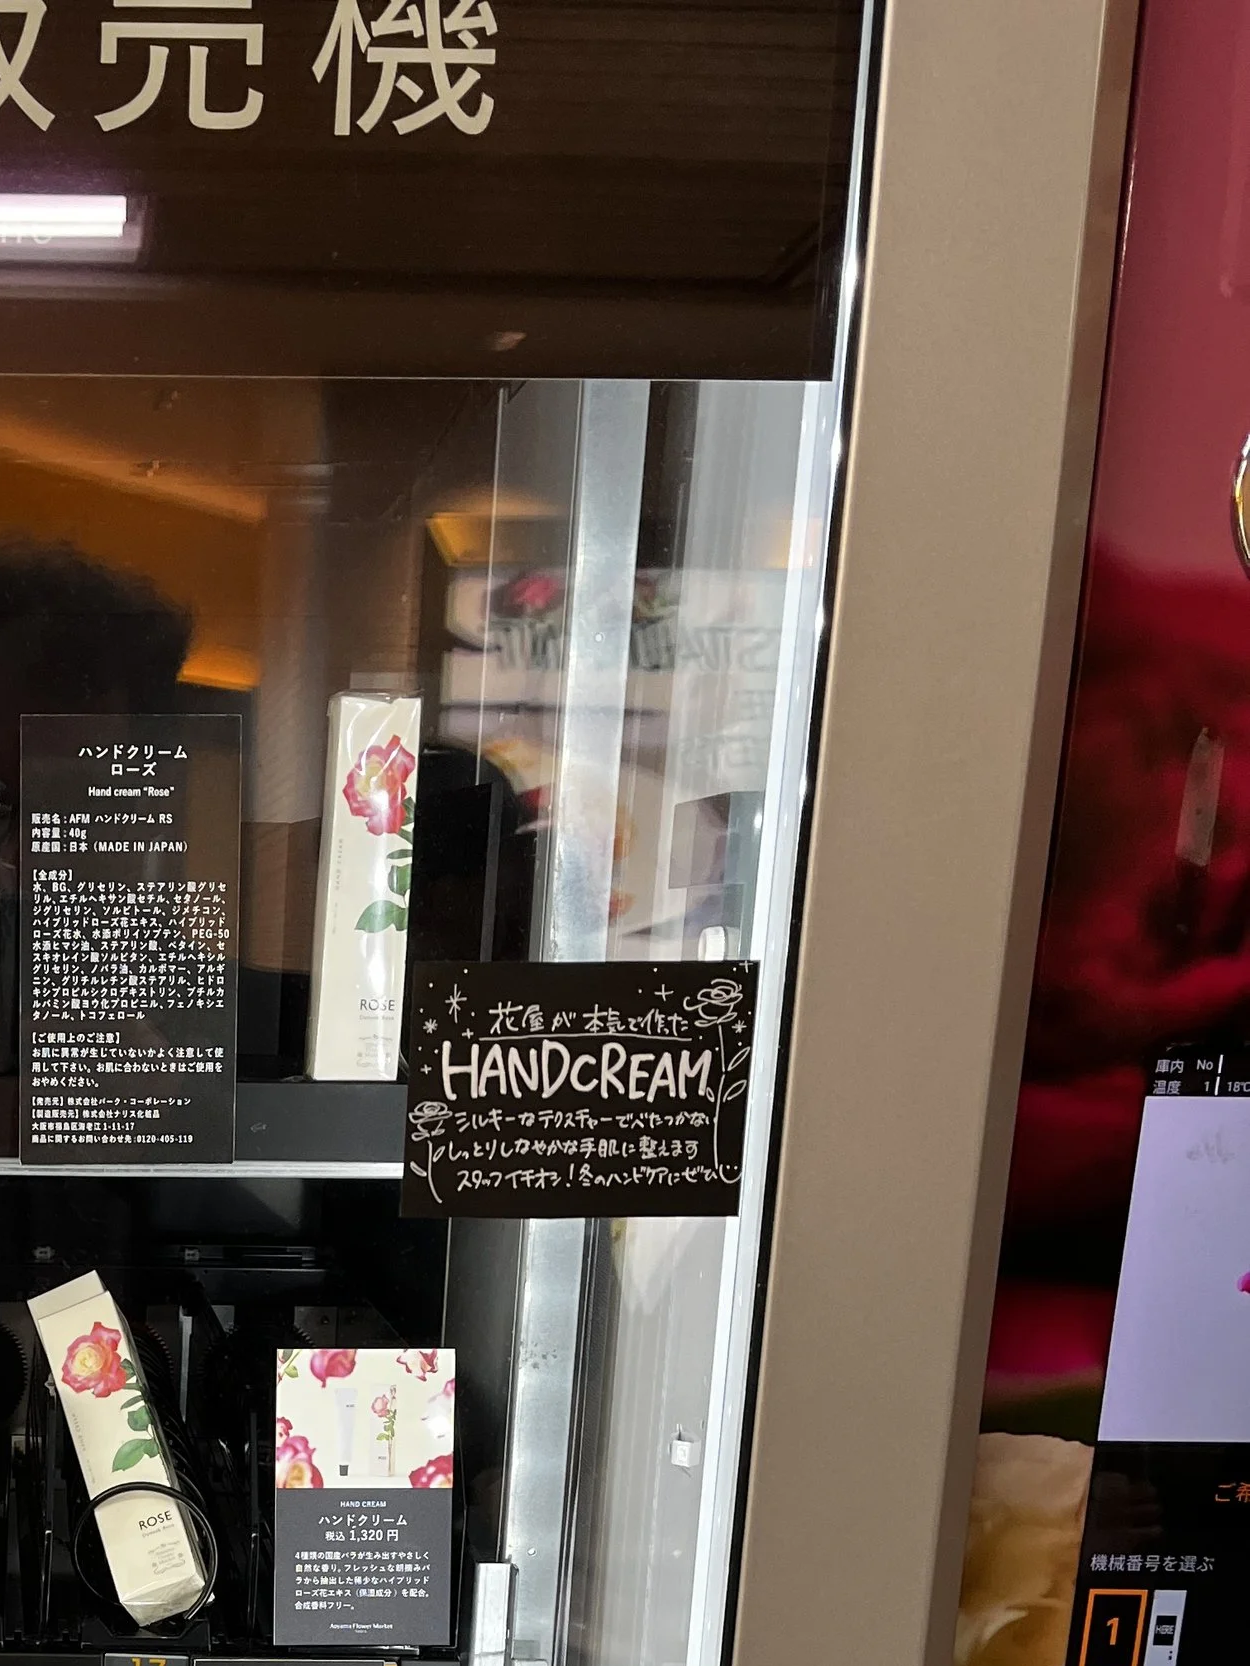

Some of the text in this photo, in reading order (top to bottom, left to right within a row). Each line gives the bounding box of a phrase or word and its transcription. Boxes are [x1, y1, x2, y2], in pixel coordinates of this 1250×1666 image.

[78, 744, 188, 760] ハンドクリーム
[111, 761, 157, 776] ローズ
[88, 786, 111, 796] Hand
[113, 788, 141, 797] cream
[95, 813, 155, 824] ハンドクリーム
[159, 813, 173, 824] RS
[32, 869, 73, 881] 【全成分】
[359, 998, 395, 1013] ROSE
[488, 1001, 690, 1036] 花屋が本気で作った
[442, 1039, 714, 1102] HANDCREAM
[1155, 1059, 1214, 1074] 庫内 No
[32, 1077, 100, 1088] おやめください。
[1152, 1080, 1182, 1095] 温度
[1204, 1081, 1211, 1092] 1
[449, 1136, 699, 1161] しっとりしなやかな手肌に整えます
[340, 1500, 387, 1508] HAND CREAM
[138, 1509, 173, 1531] ROSE
[318, 1514, 408, 1527] ハンドクリーム
[325, 1529, 399, 1543] 税込 1,320 円
[1090, 1554, 1215, 1573] 機械番号を選ぶ
[1106, 1617, 1120, 1646] 1
